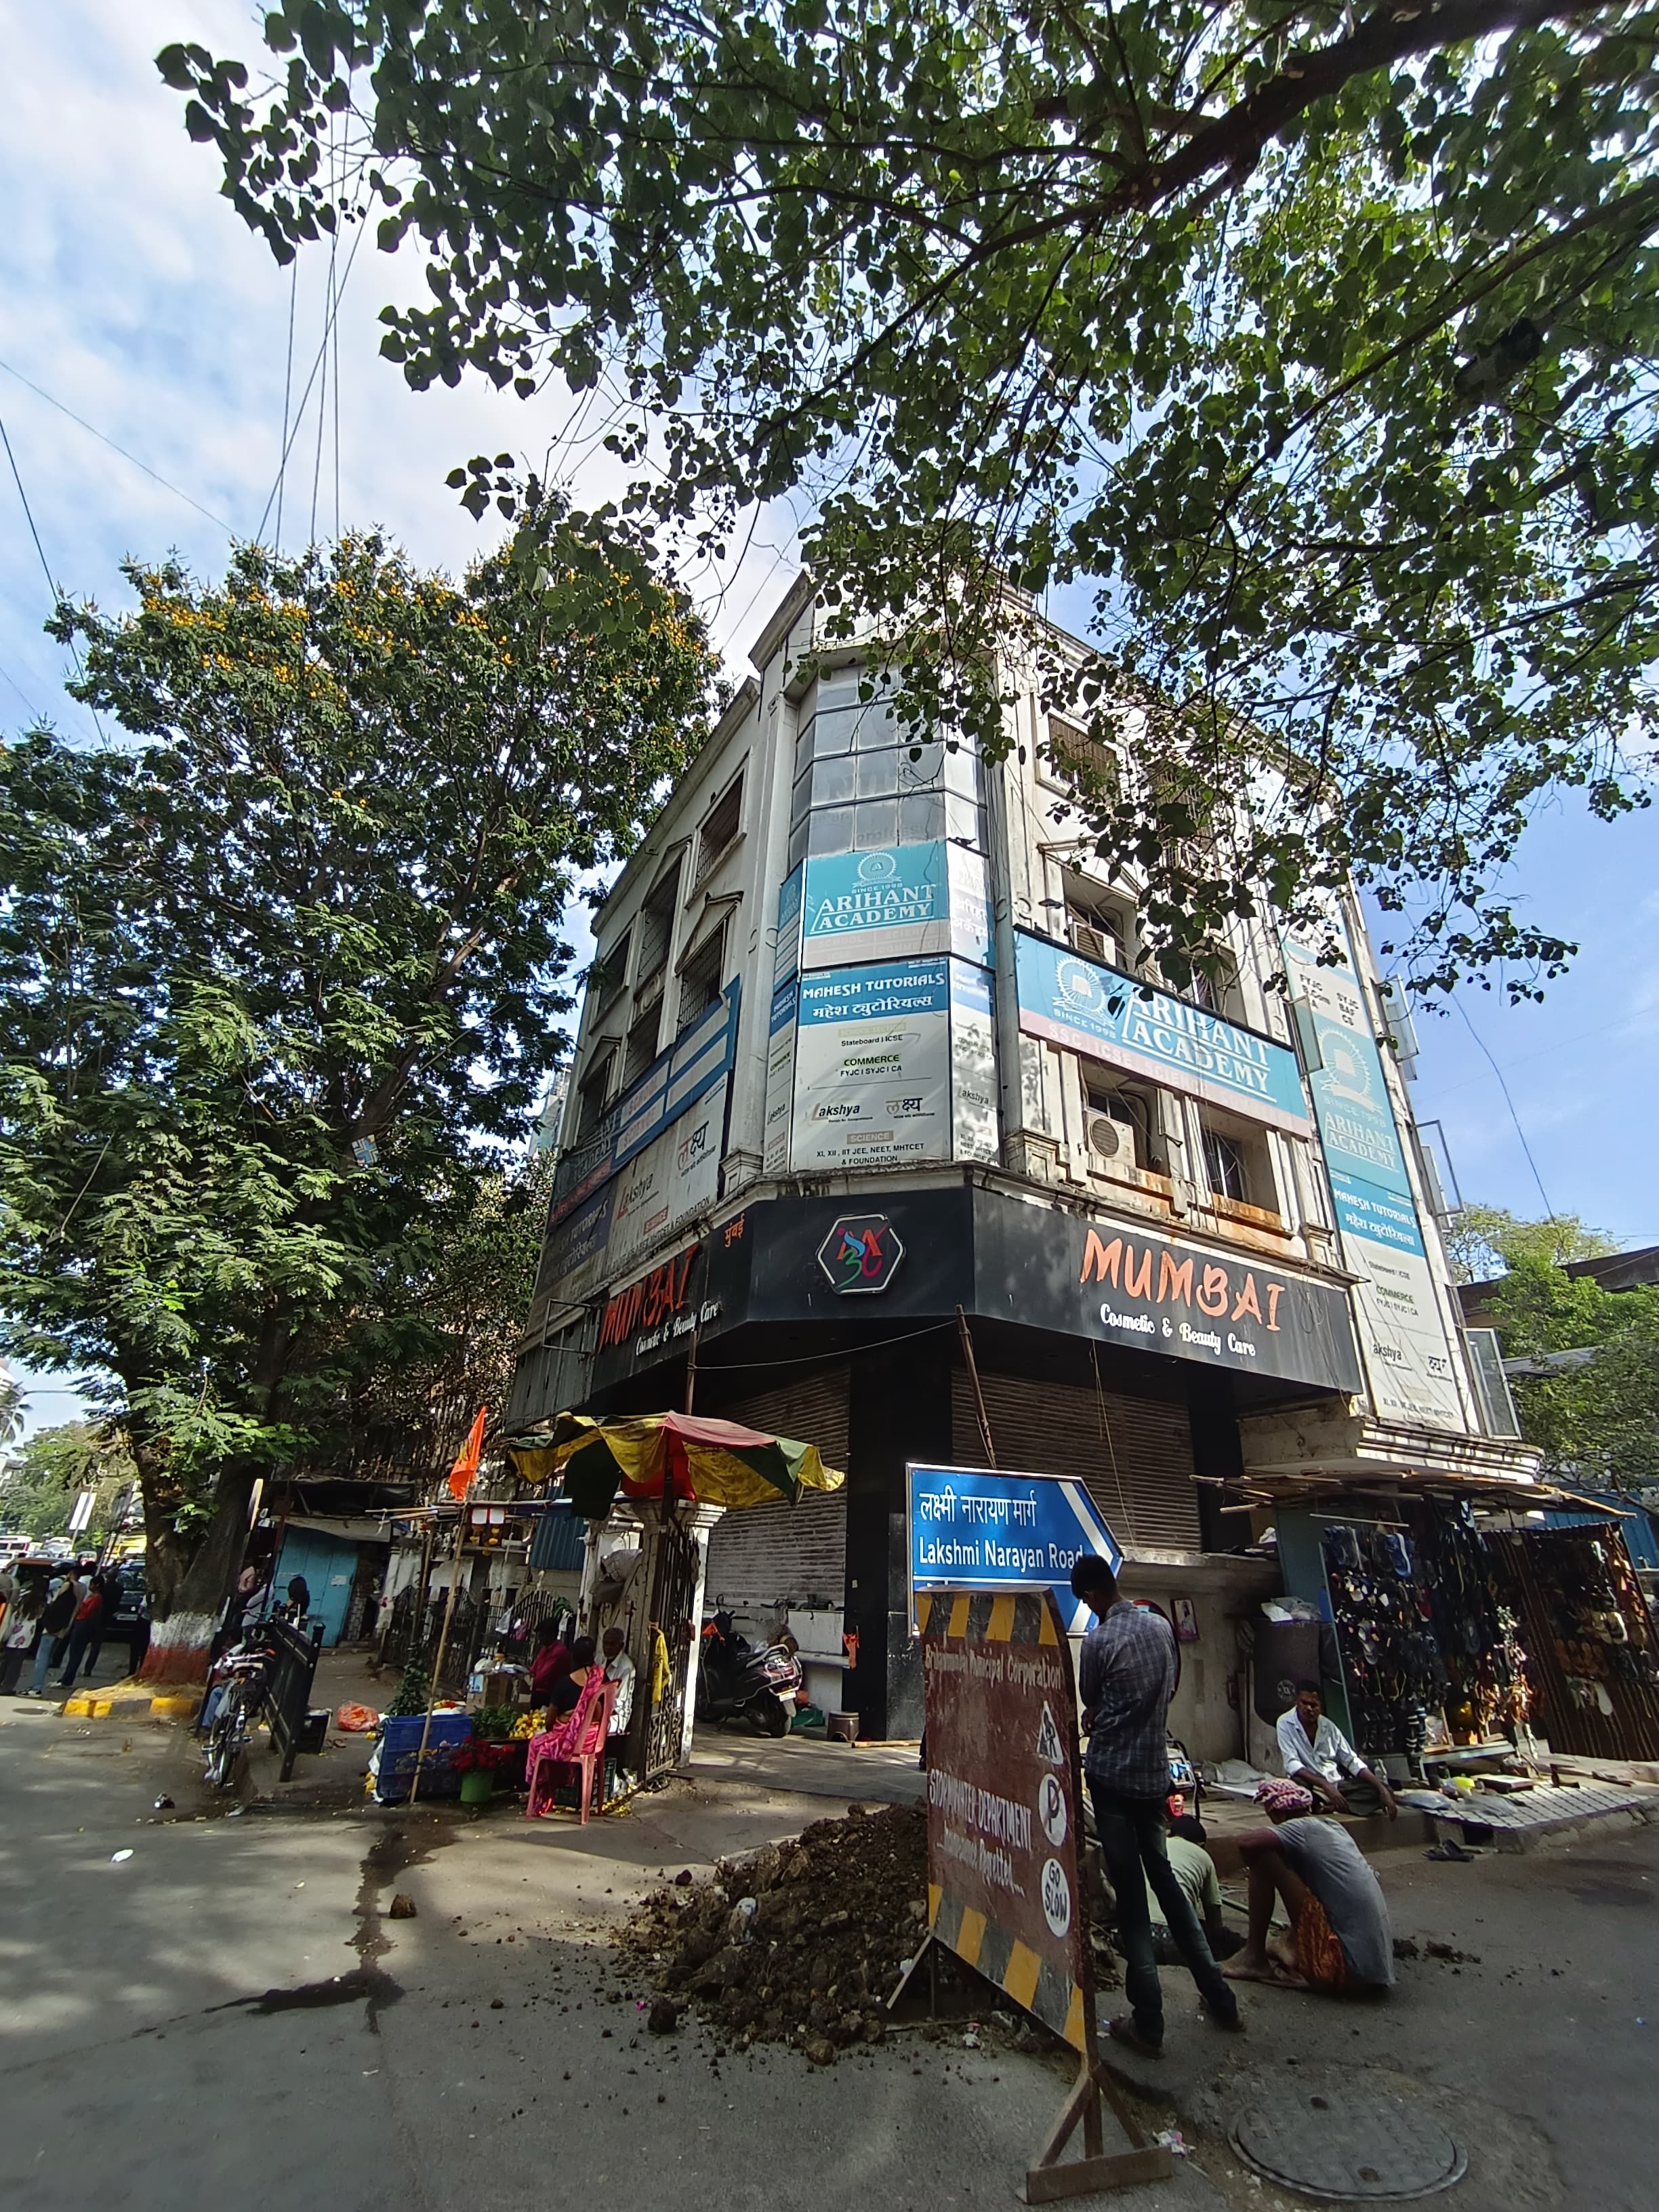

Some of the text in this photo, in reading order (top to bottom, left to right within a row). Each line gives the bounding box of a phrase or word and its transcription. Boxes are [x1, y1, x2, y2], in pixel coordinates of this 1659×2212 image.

[821, 884, 936, 912] ARIHANT
[852, 885, 879, 894] SINCE
[819, 903, 930, 929] ACADEMY
[803, 983, 861, 999] MAHESH
[865, 972, 945, 991] TUTORIALS
[813, 1004, 848, 1019] महेश
[1054, 1008, 1116, 1039] SINCE 1998
[1130, 989, 1271, 1065] ARIHANT
[842, 1038, 880, 1046] Stateboard
[1048, 1023, 1082, 1046] SSC
[1094, 1042, 1132, 1066] ICSE
[1132, 1019, 1269, 1092] ACADEMY
[844, 1054, 899, 1066] COMMERCE
[851, 1132, 890, 1143] SCIENCE
[893, 1143, 924, 1151] MHTCET
[1326, 1112, 1395, 1151] ARIHANT
[849, 1155, 898, 1165] FOUNDATION
[1329, 1132, 1396, 1168] ACADEMY
[1334, 1189, 1371, 1210] MAHESH
[724, 1214, 745, 1247] मुंबई
[1080, 1228, 1286, 1332] MUMBAI
[1376, 1285, 1414, 1304] COMMERCE
[598, 1244, 700, 1354] MUMBAI
[673, 1311, 697, 1338] Beauty
[700, 1300, 720, 1323] Care
[1100, 1303, 1256, 1357] Cosmetic & Beauty Care
[919, 1484, 1037, 1527] लक्ष्मी नारायण मार्ग
[919, 1536, 1084, 1573] Lakshmi Narayan Road
[1007, 1654, 1063, 1695] Corporation
[978, 1788, 1032, 1852] DEPARTMENT
[1048, 1861, 1061, 1888] GO
[1044, 1883, 1067, 1923] SLOW
